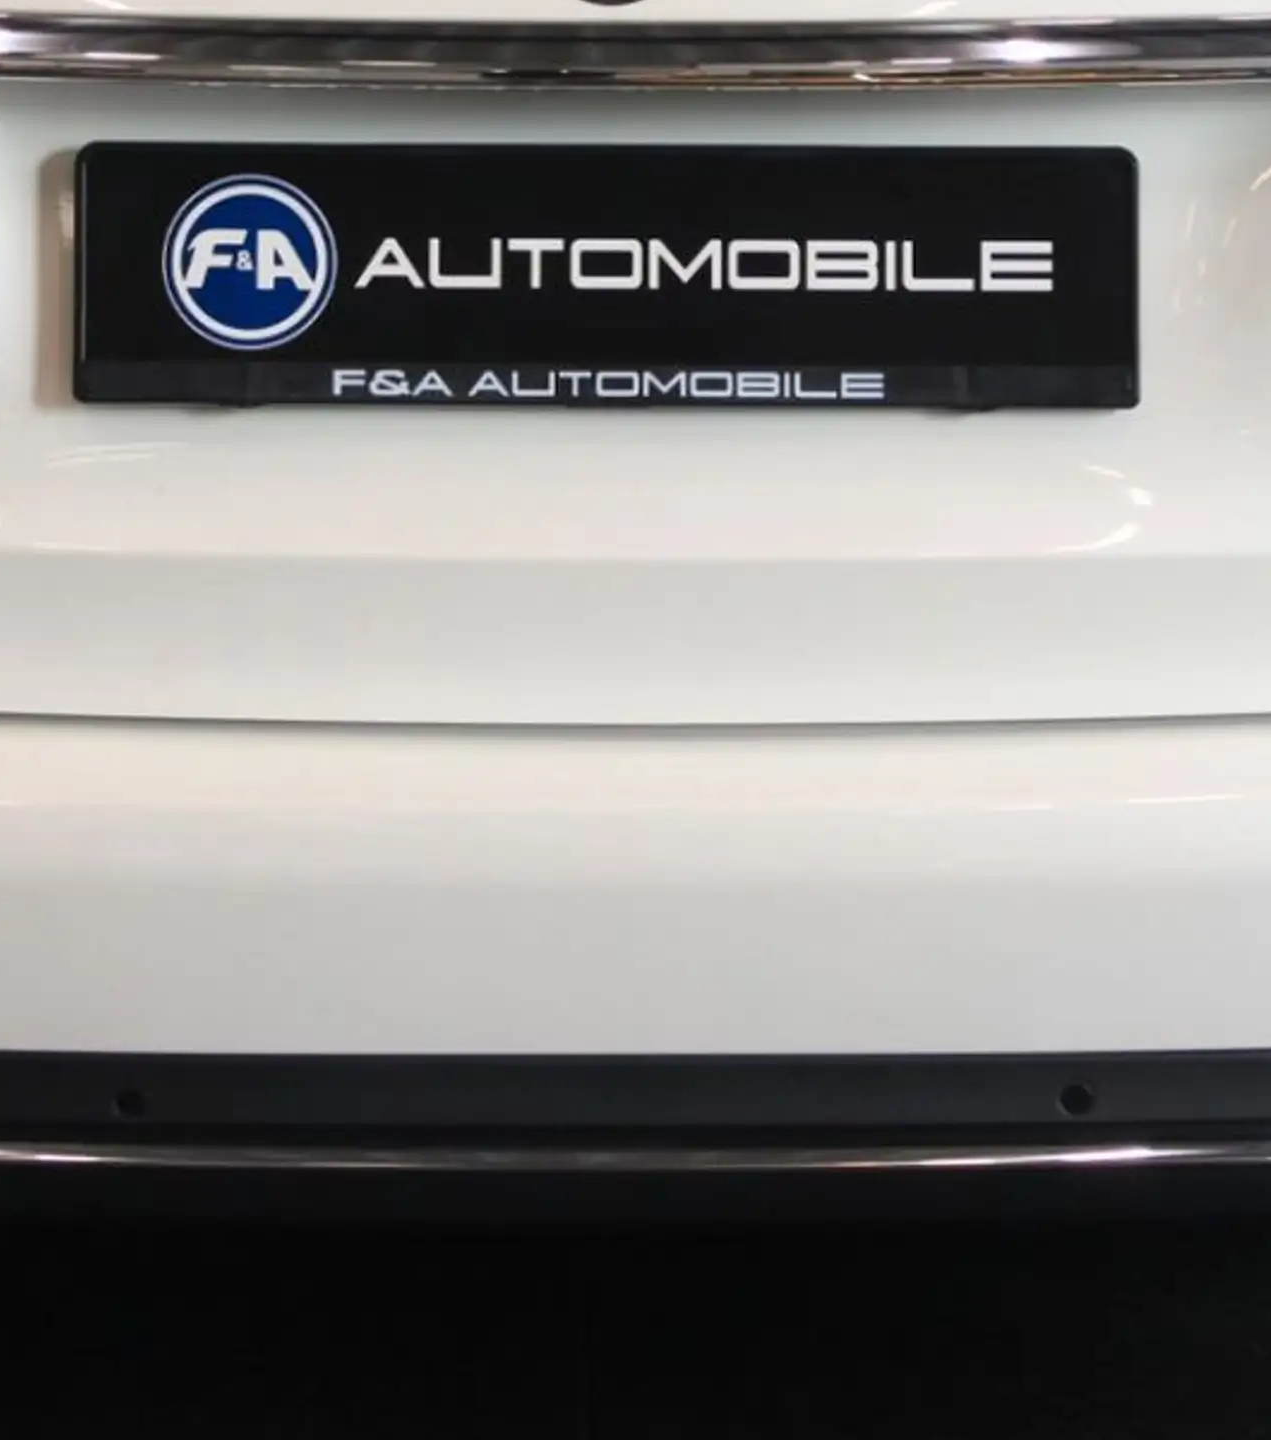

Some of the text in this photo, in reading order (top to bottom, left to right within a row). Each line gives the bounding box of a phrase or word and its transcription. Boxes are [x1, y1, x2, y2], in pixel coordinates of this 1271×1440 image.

[181, 230, 1054, 291] F&A AUTOMOBILE
[332, 369, 885, 398] F&A AUTOMOBILE
